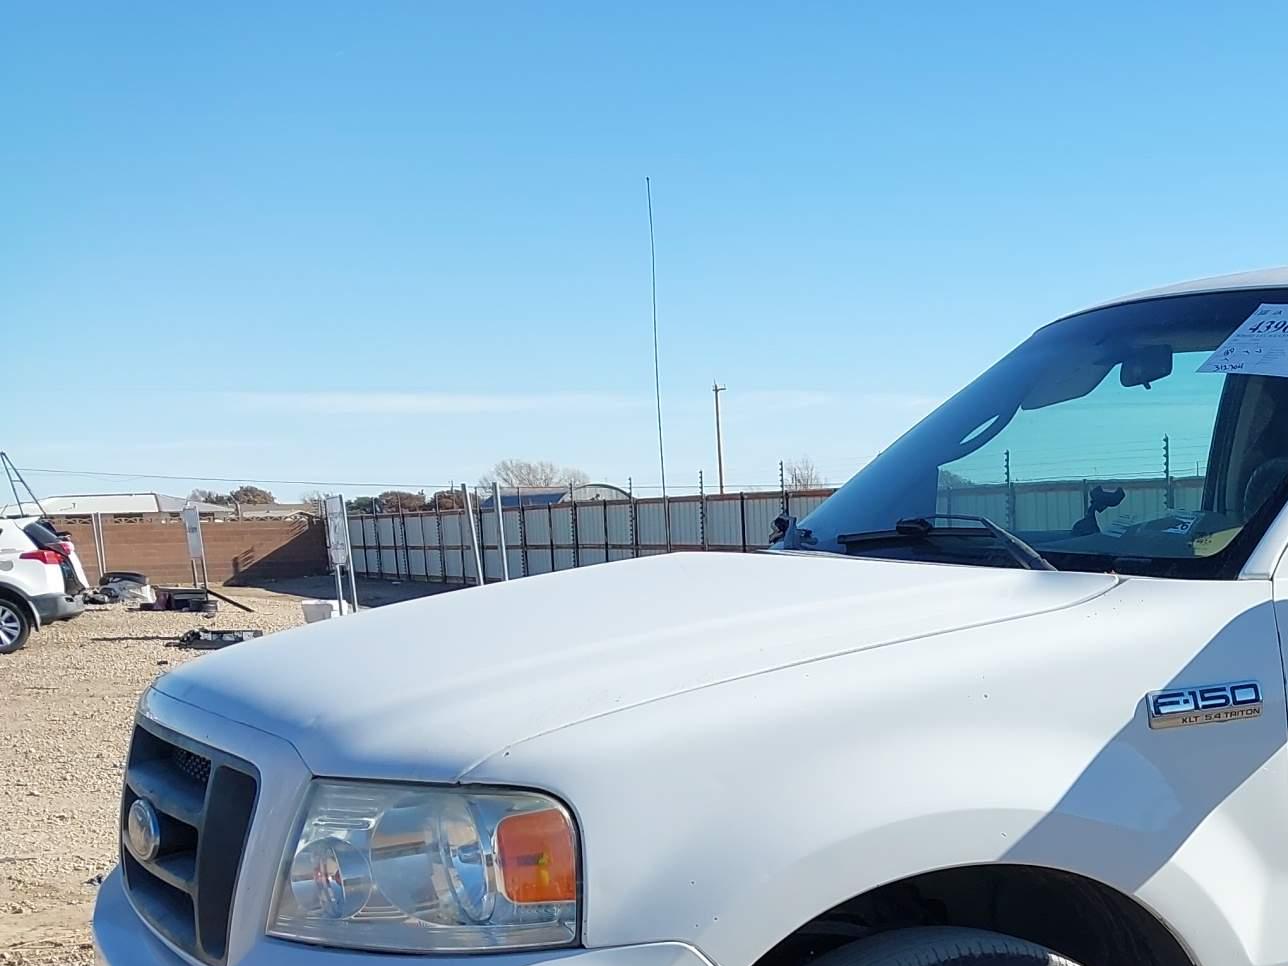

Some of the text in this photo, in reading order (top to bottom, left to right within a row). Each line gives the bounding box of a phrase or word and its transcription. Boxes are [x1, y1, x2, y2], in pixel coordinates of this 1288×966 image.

[1152, 683, 1261, 716] F-150
[1181, 715, 1200, 724] XLT
[1224, 708, 1260, 718] TRITON
